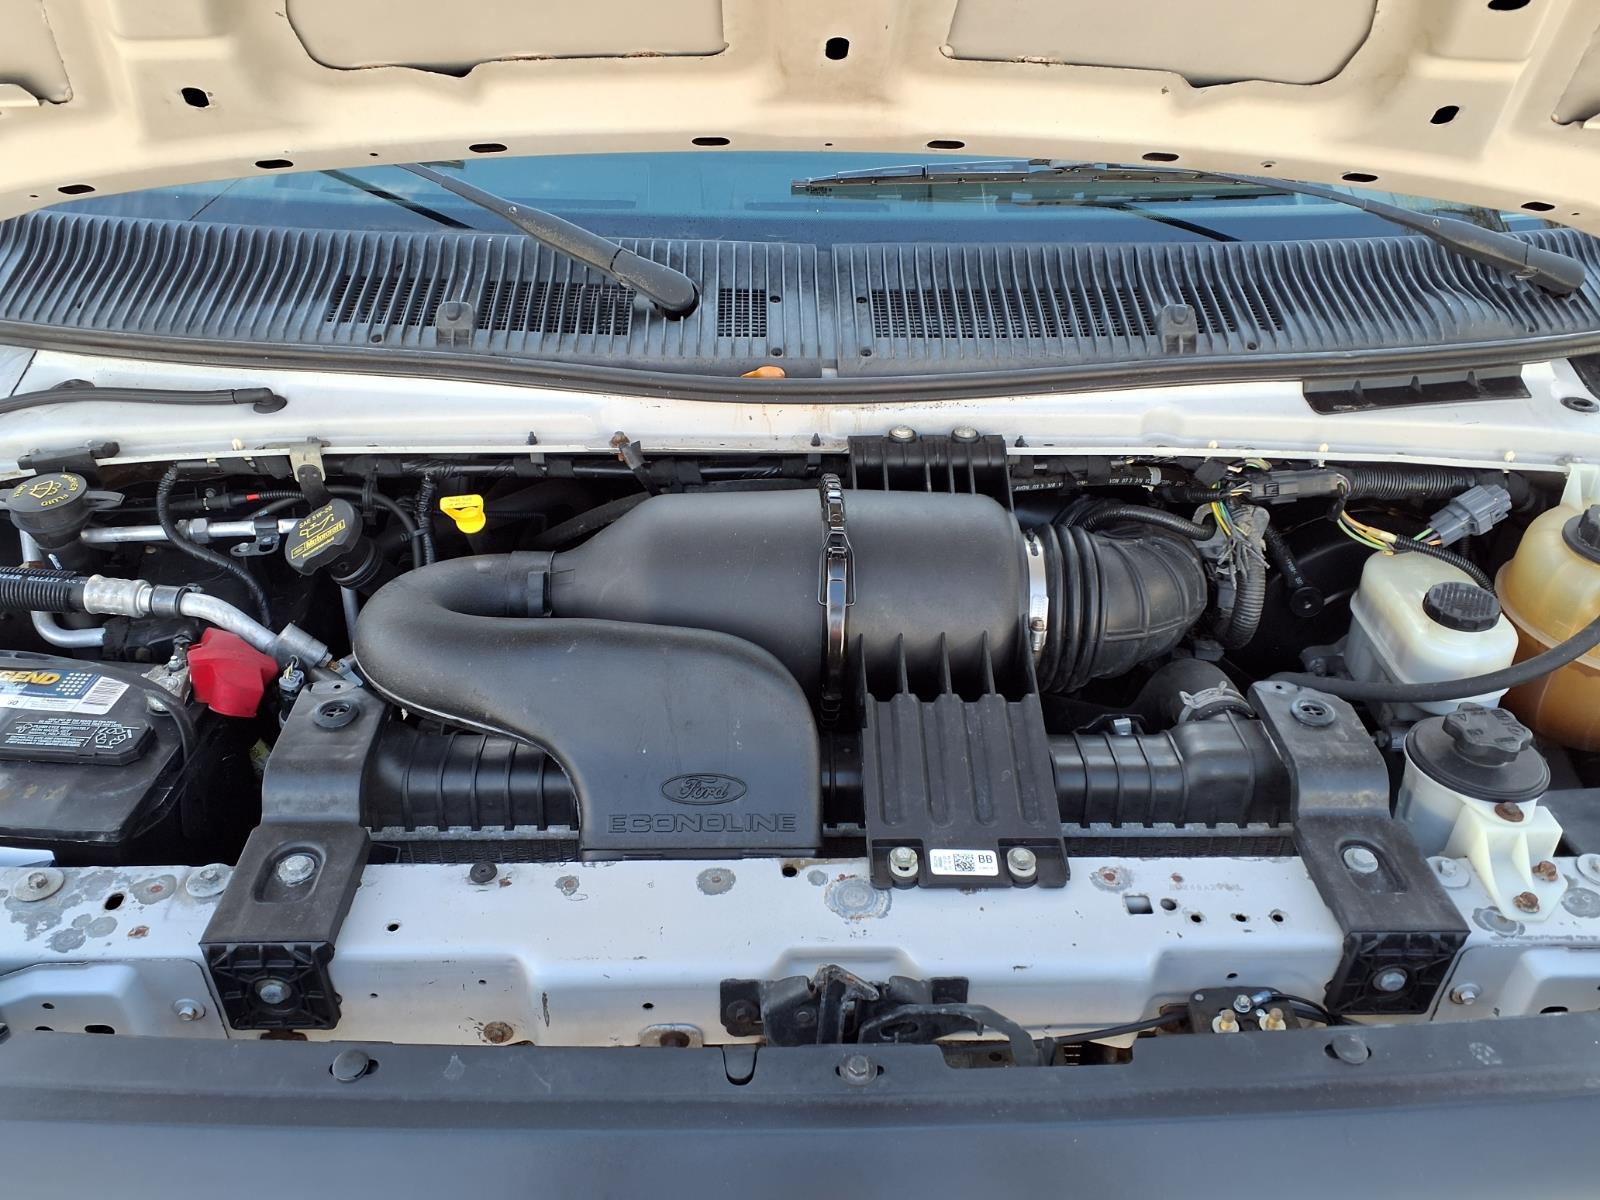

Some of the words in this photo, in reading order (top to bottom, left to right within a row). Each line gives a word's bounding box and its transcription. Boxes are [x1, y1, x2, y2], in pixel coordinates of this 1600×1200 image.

[40, 493, 69, 507] FLUID
[299, 518, 310, 529] SAE
[305, 522, 342, 549] Motorcraft
[27, 575, 61, 583] GALAXY
[679, 776, 729, 800] Ford
[608, 813, 797, 833] ECONOLINE
[977, 854, 993, 864] BB
